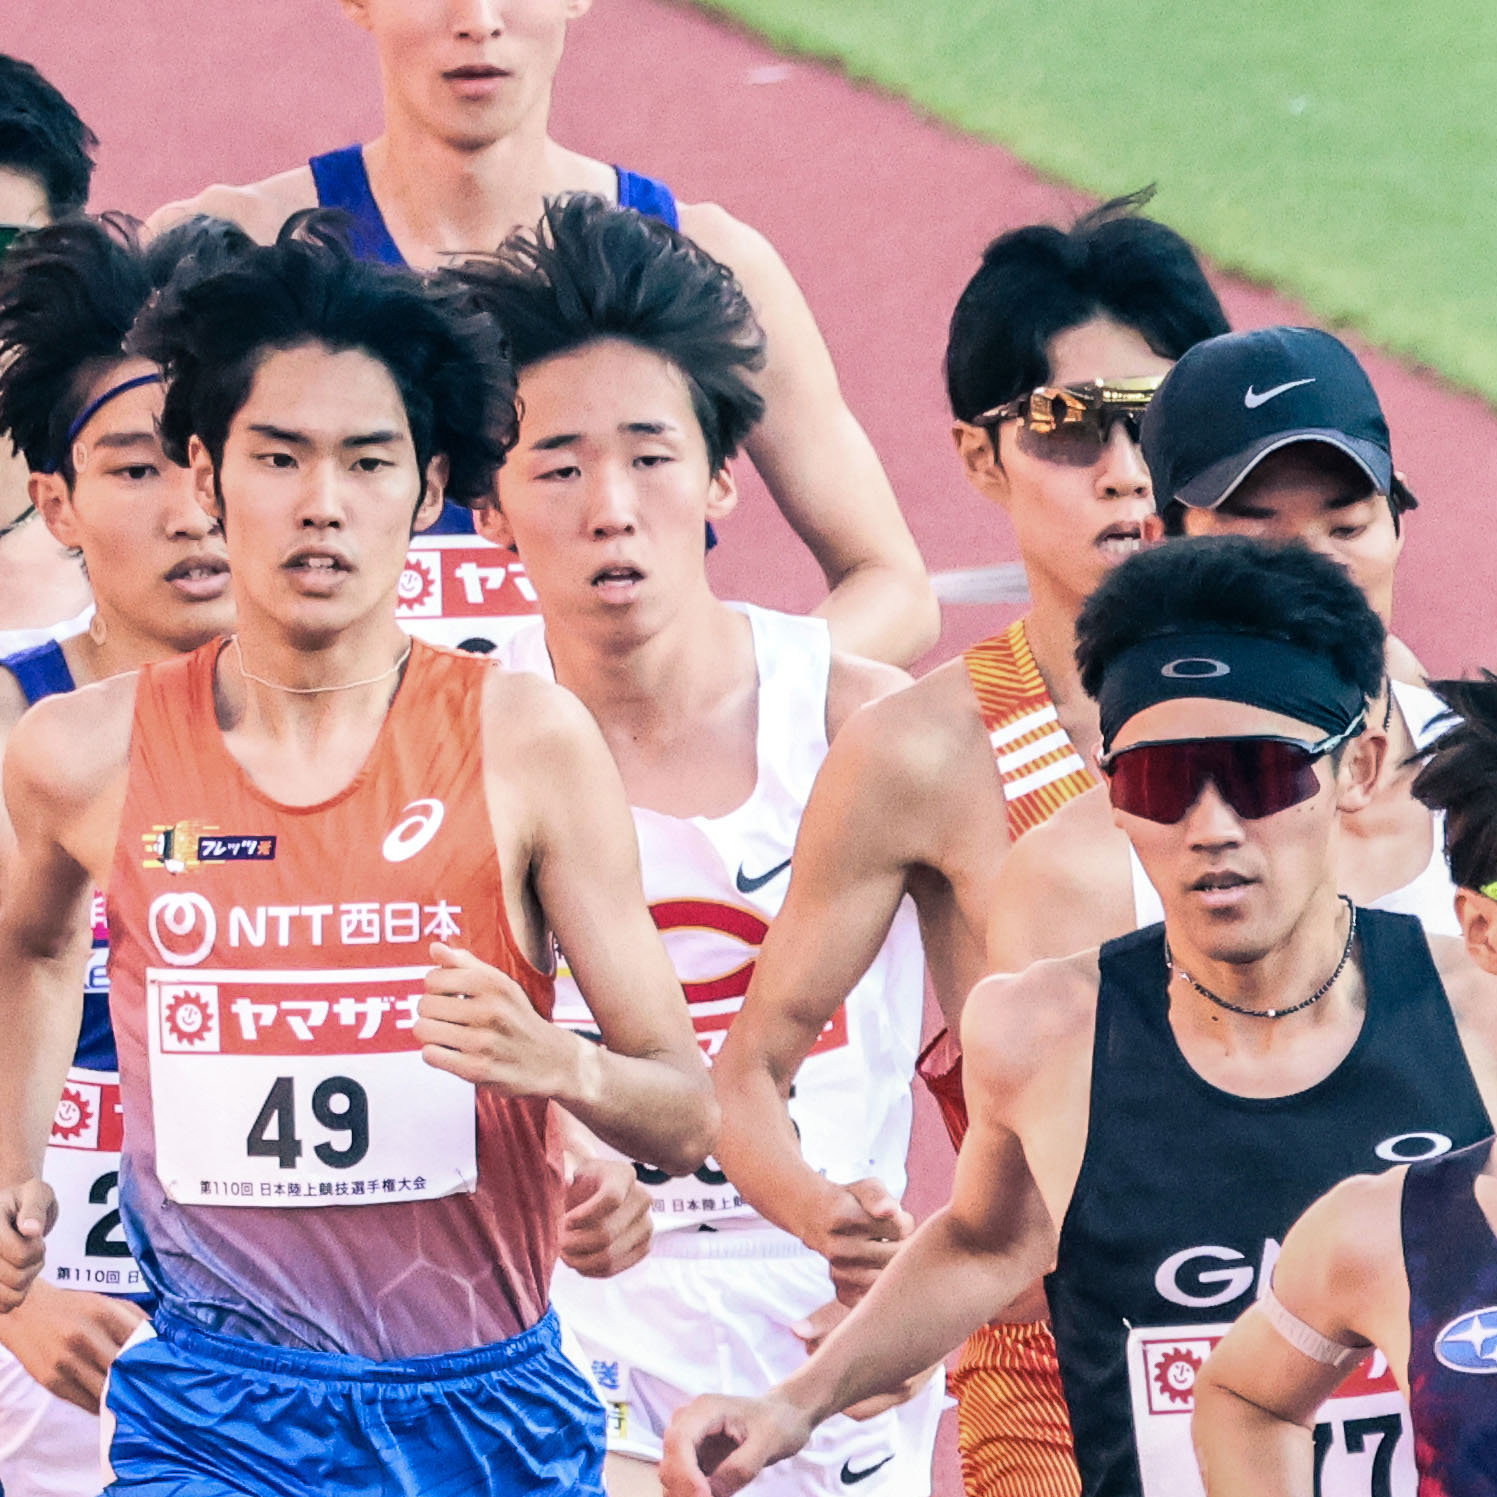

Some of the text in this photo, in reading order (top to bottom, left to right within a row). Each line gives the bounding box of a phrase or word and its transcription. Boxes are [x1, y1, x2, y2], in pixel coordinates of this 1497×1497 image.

[246, 1075, 370, 1170] 49
[200, 1177, 428, 1199] 第110回 日本陸上競技選手権大会
